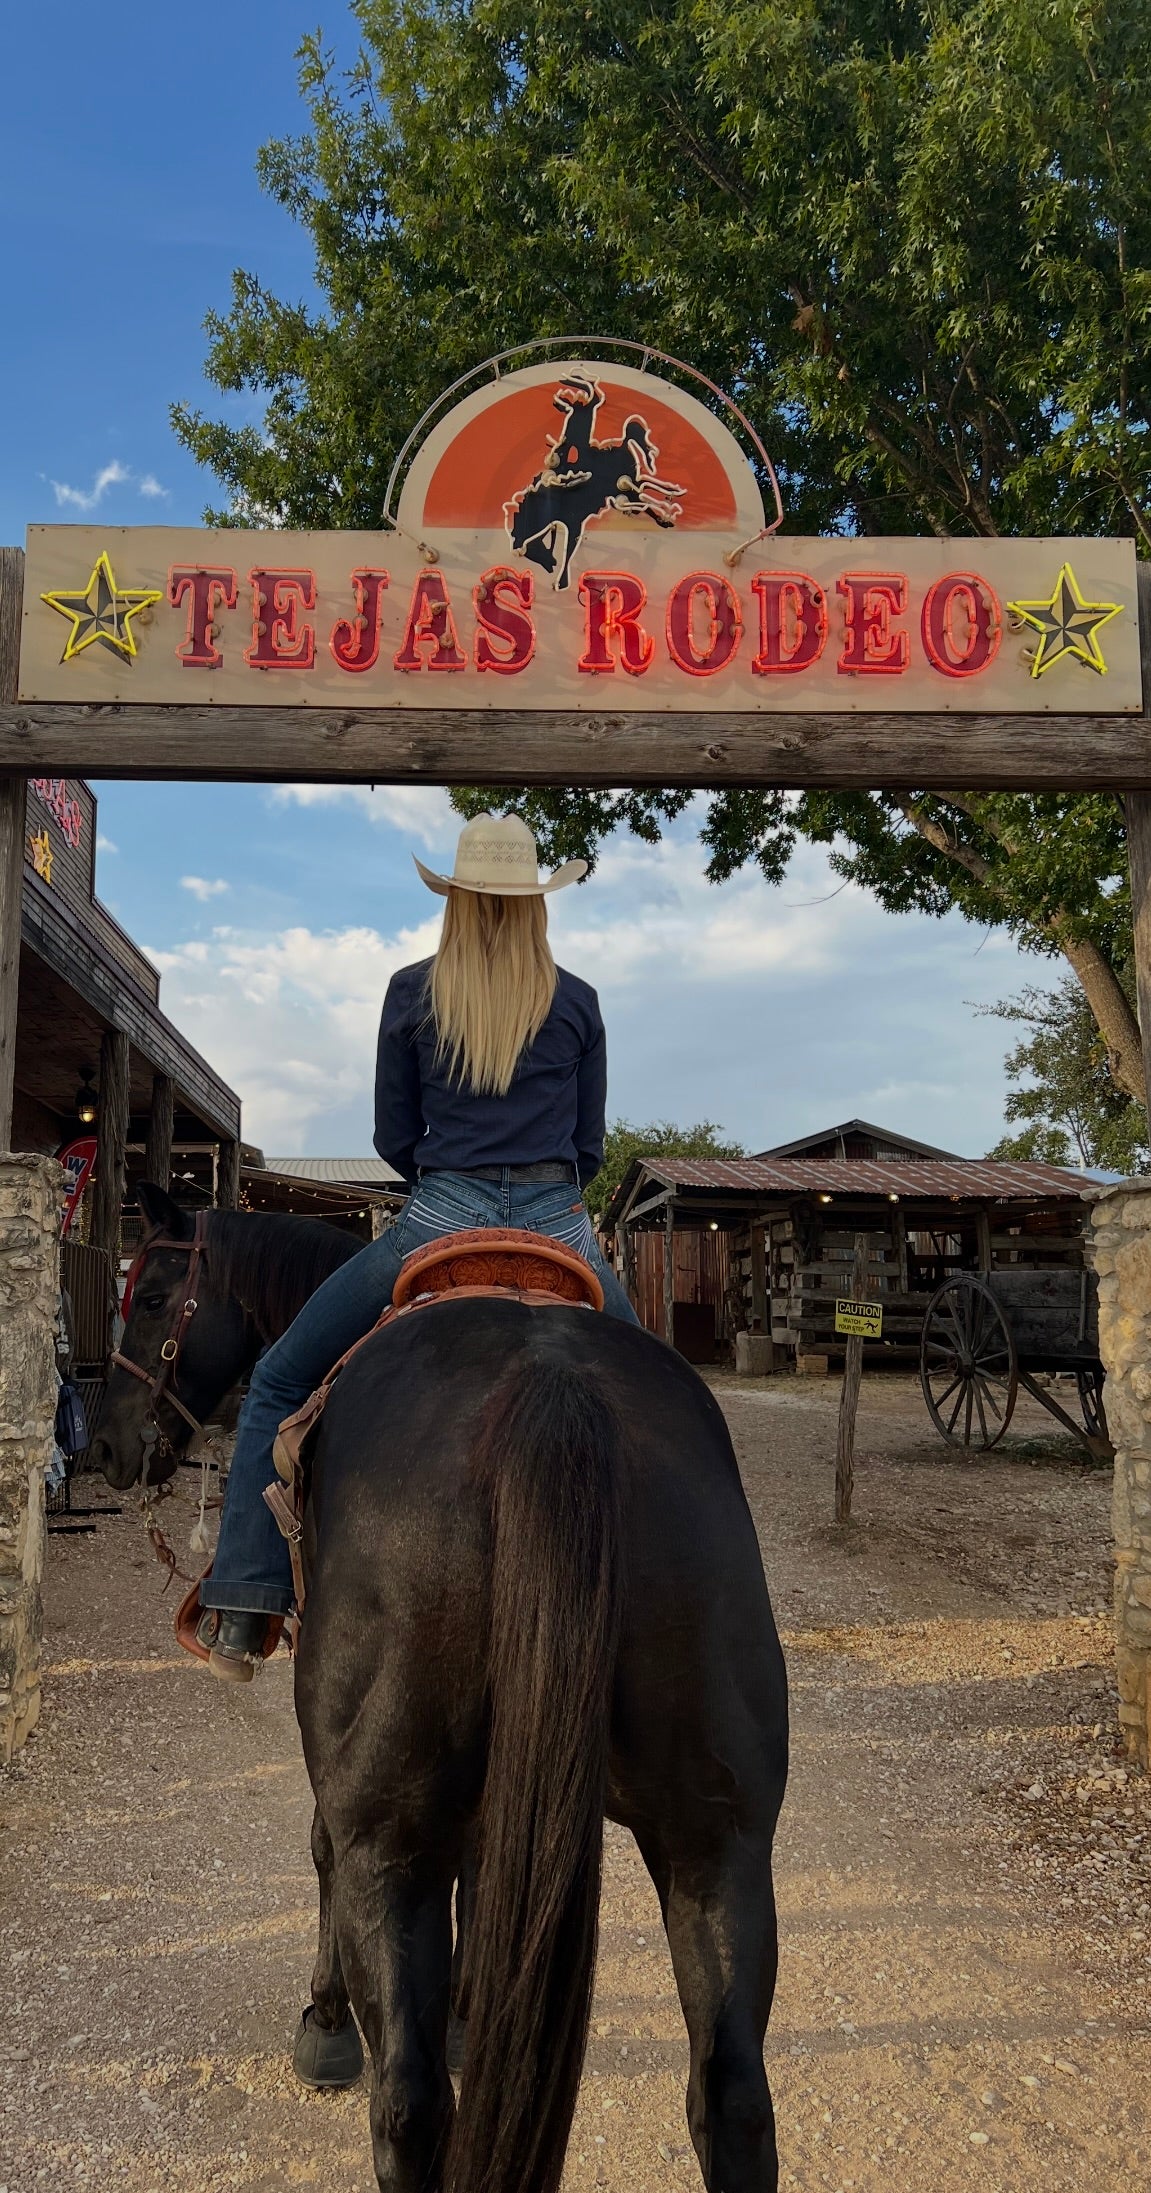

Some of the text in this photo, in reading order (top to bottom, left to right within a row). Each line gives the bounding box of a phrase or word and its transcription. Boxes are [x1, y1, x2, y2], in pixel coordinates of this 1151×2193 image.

[167, 564, 1003, 677] TEJAS RODEO
[839, 1303, 880, 1317] CAUTION
[843, 1317, 861, 1325] WATCH
[838, 1323, 865, 1333] YOUR STEP
